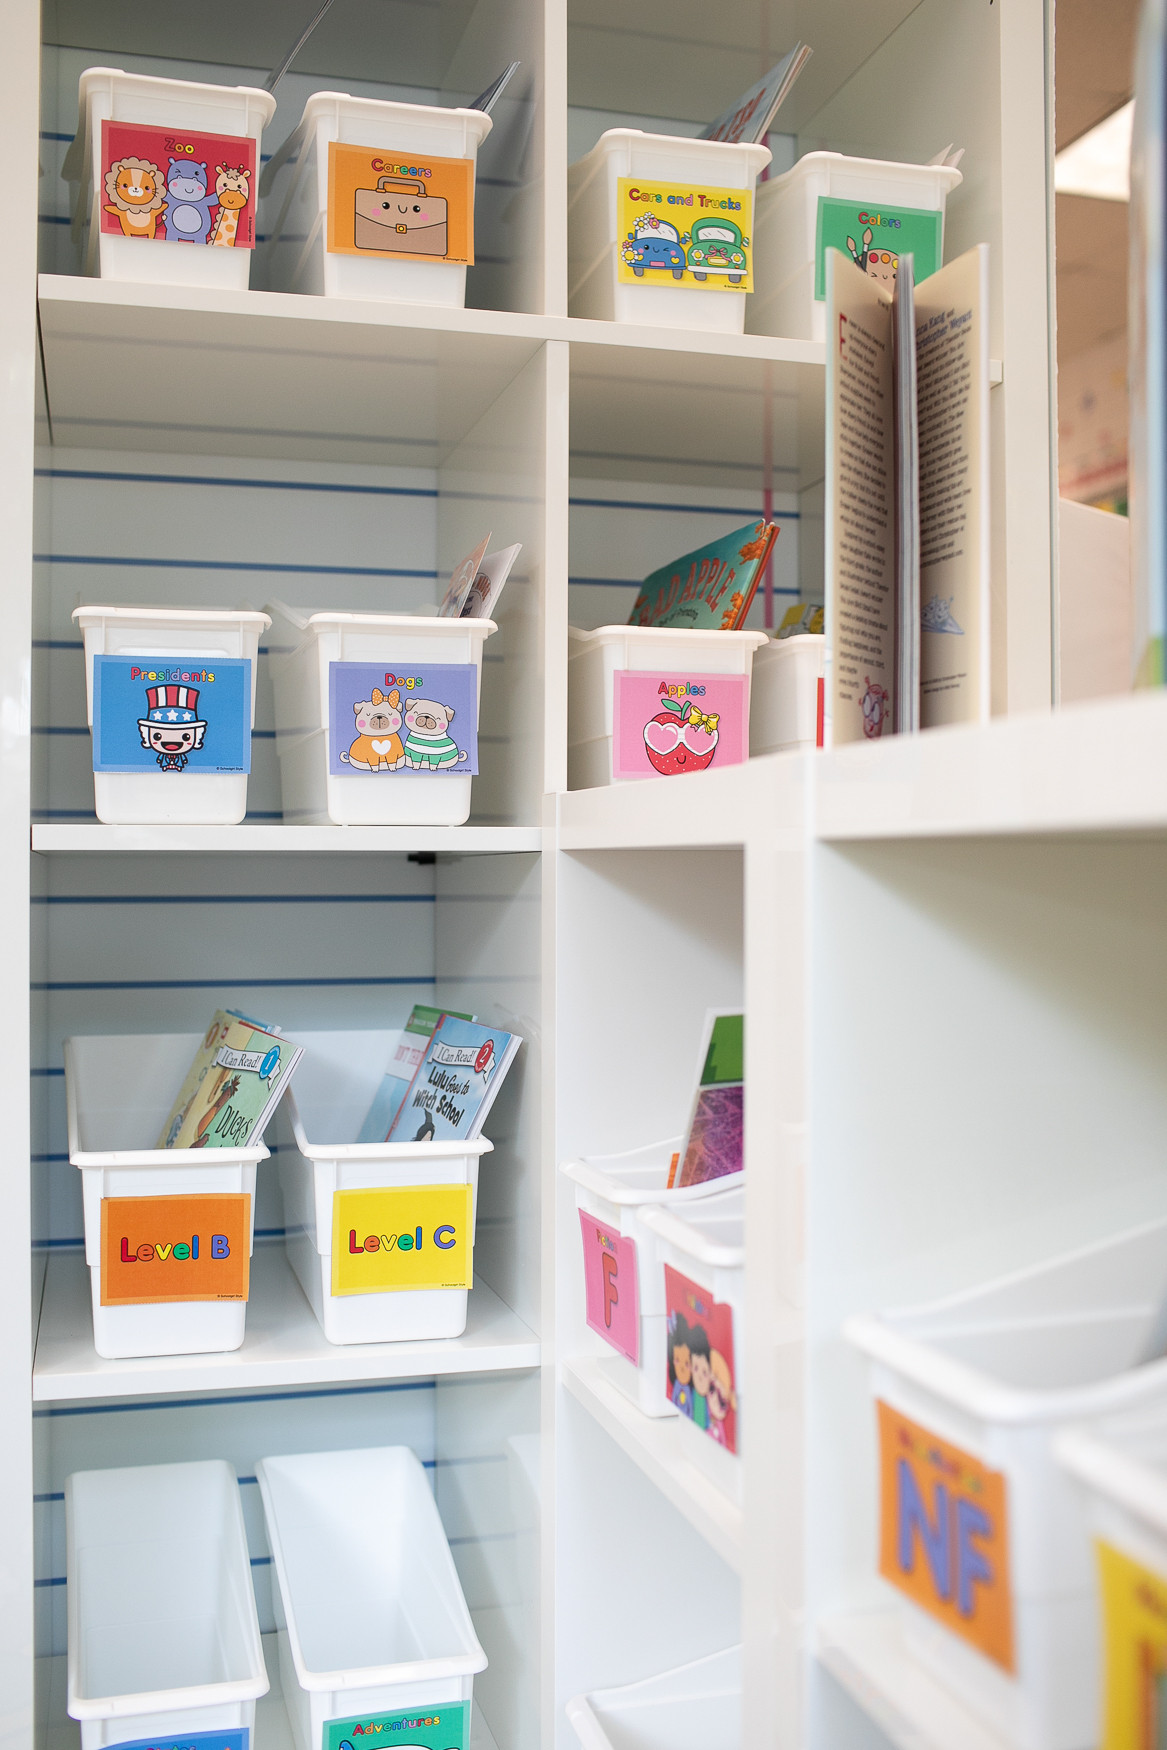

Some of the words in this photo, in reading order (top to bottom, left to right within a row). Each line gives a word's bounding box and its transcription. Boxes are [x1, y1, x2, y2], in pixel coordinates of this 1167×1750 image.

[164, 137, 195, 155] Zoo
[371, 158, 432, 178] Careers
[628, 187, 663, 204] Cars
[667, 193, 694, 207] and
[697, 194, 741, 211] Trucks
[858, 211, 902, 229] Colors
[677, 557, 736, 613] APPLE
[130, 666, 215, 683] Presidents
[384, 672, 423, 690] Dogs
[657, 681, 706, 698] Apples
[224, 1053, 238, 1066] Can
[239, 1053, 262, 1069] Read!
[265, 1055, 274, 1070] 1
[441, 1049, 455, 1062] Can
[455, 1049, 477, 1063] Read!
[480, 1047, 490, 1063] 2
[427, 1066, 449, 1090] Lulu
[445, 1074, 461, 1095] Goes
[460, 1080, 471, 1096] to
[412, 1089, 438, 1110] Witch
[435, 1094, 465, 1127] School
[120, 1235, 199, 1263] Level
[211, 1234, 231, 1260] B
[349, 1226, 422, 1255] Level
[433, 1224, 456, 1250] C
[602, 1251, 618, 1328] F
[897, 1457, 993, 1617] NF
[352, 1716, 440, 1736] Adventures
